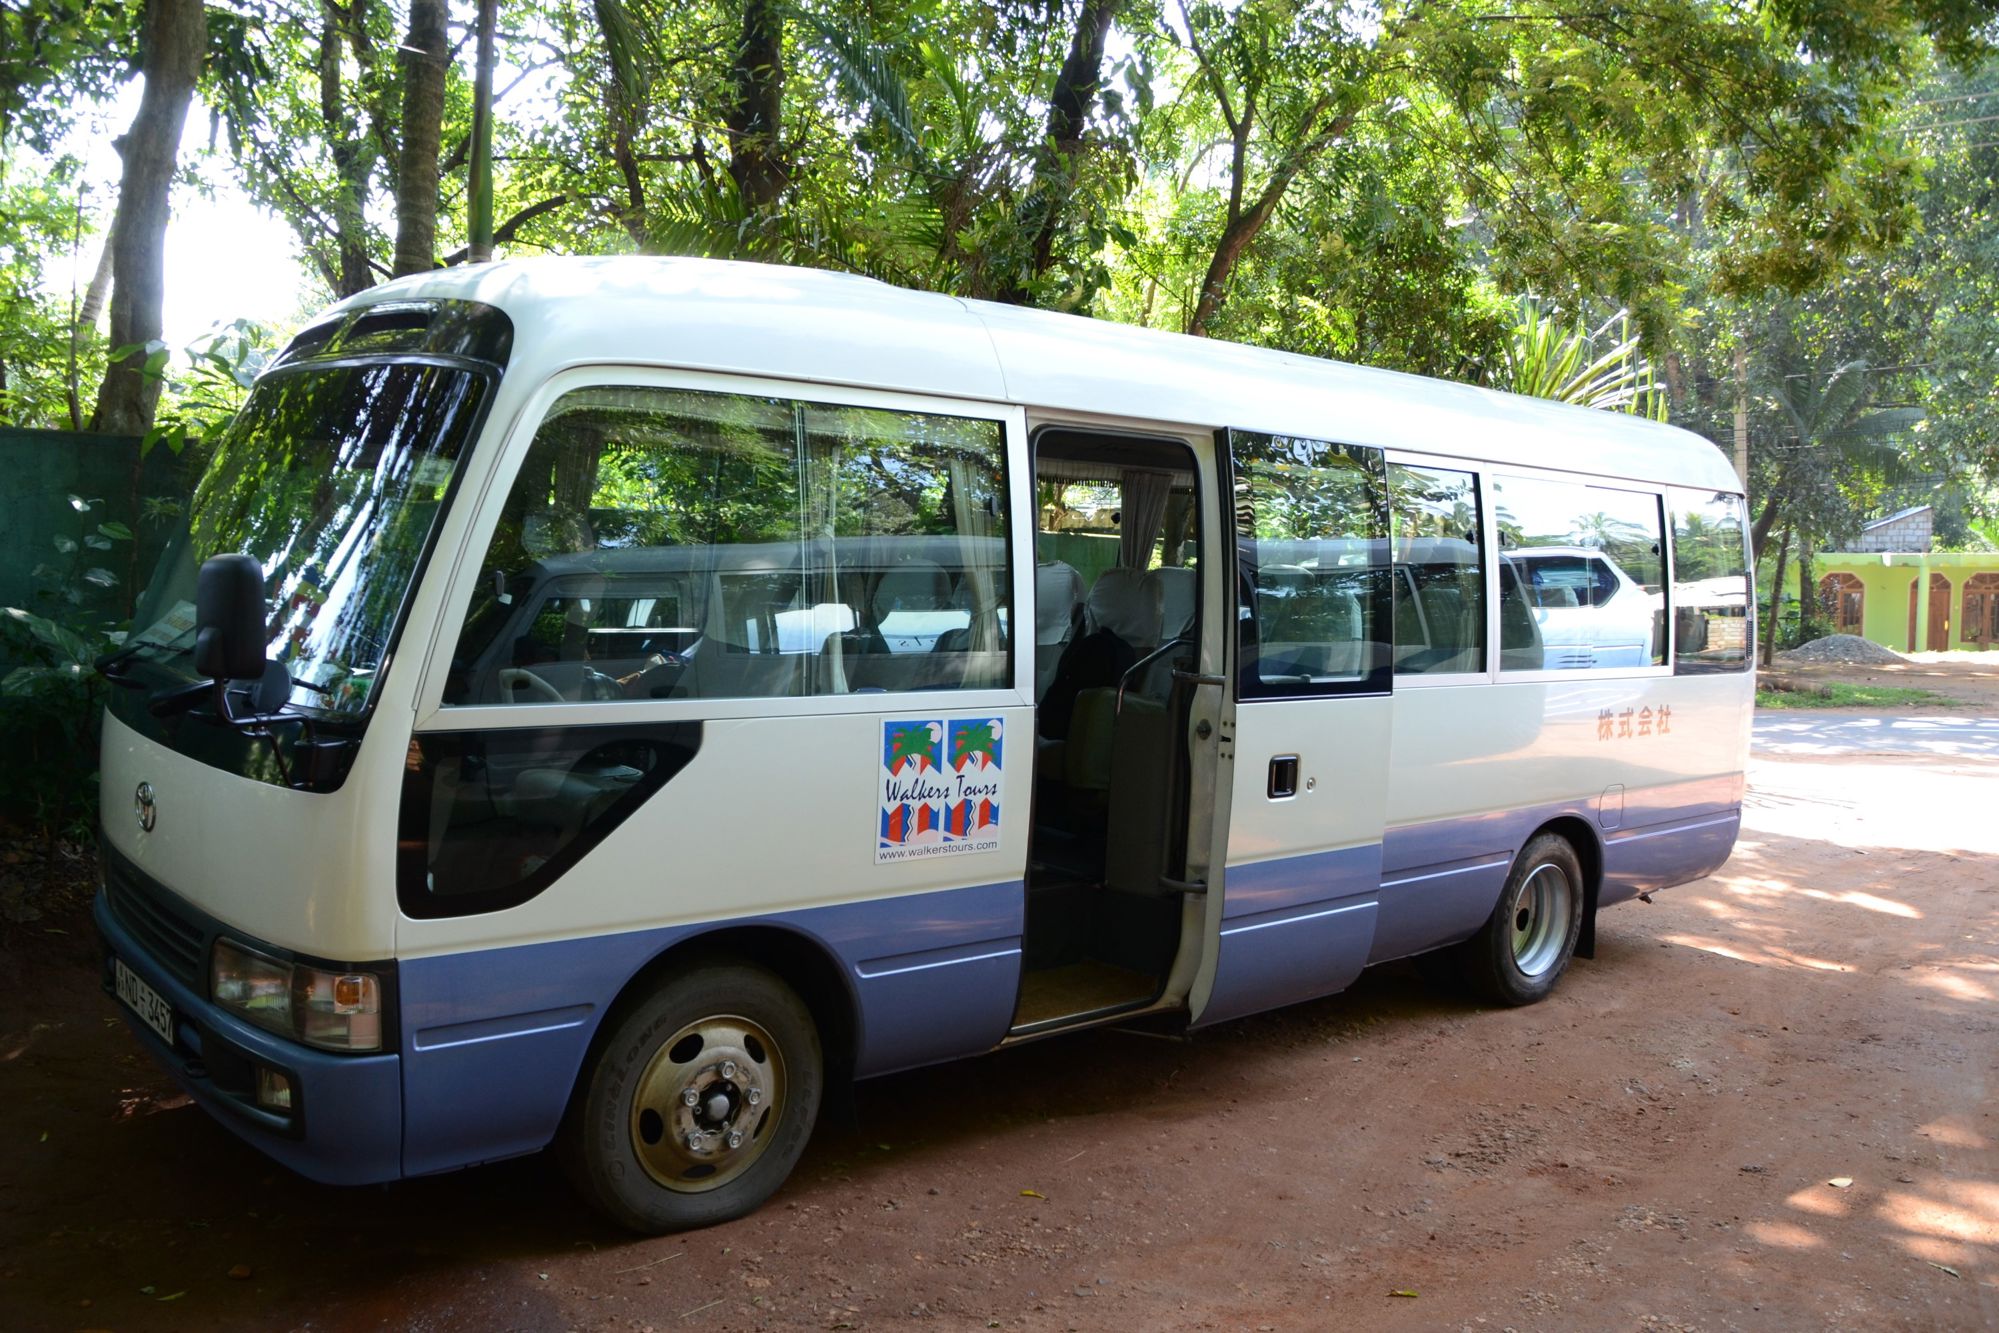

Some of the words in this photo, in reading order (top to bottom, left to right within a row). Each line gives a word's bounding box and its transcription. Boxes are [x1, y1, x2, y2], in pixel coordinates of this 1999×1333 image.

[1597, 704, 1671, 741] 株式会社
[885, 777, 950, 803] Walkers
[956, 774, 998, 798] Tours
[879, 840, 998, 860] www.walkerstours.com
